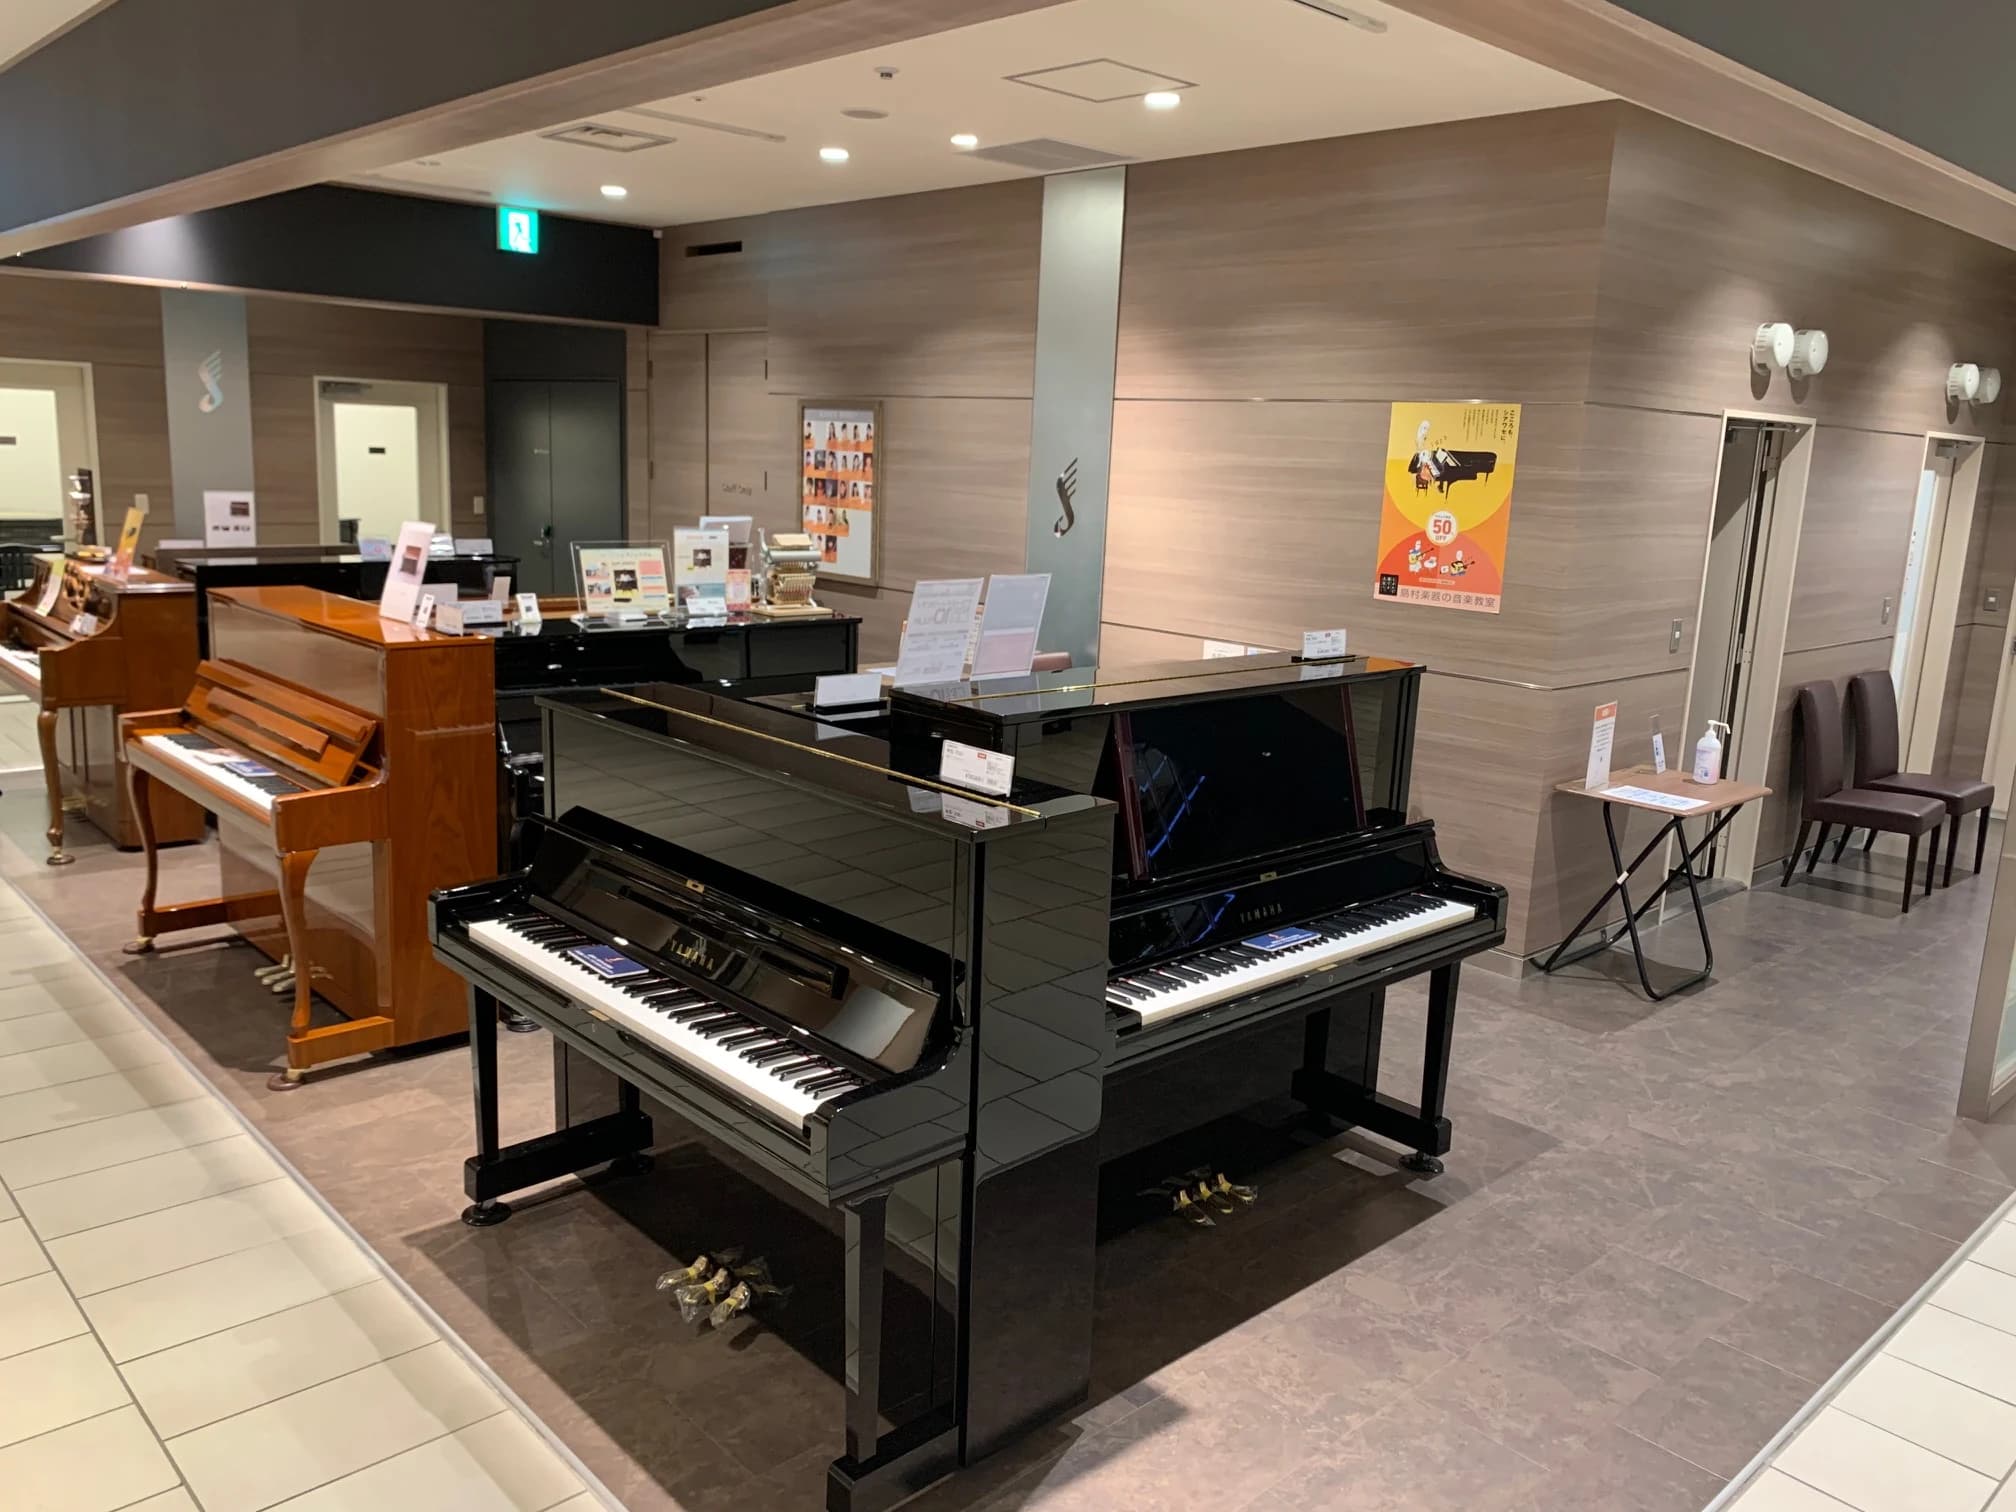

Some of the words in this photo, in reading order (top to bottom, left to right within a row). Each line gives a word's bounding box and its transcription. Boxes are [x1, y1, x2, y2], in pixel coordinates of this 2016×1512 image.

[1399, 588, 1496, 608] 島村楽器の音楽教室
[1240, 903, 1283, 924] YAMAHA
